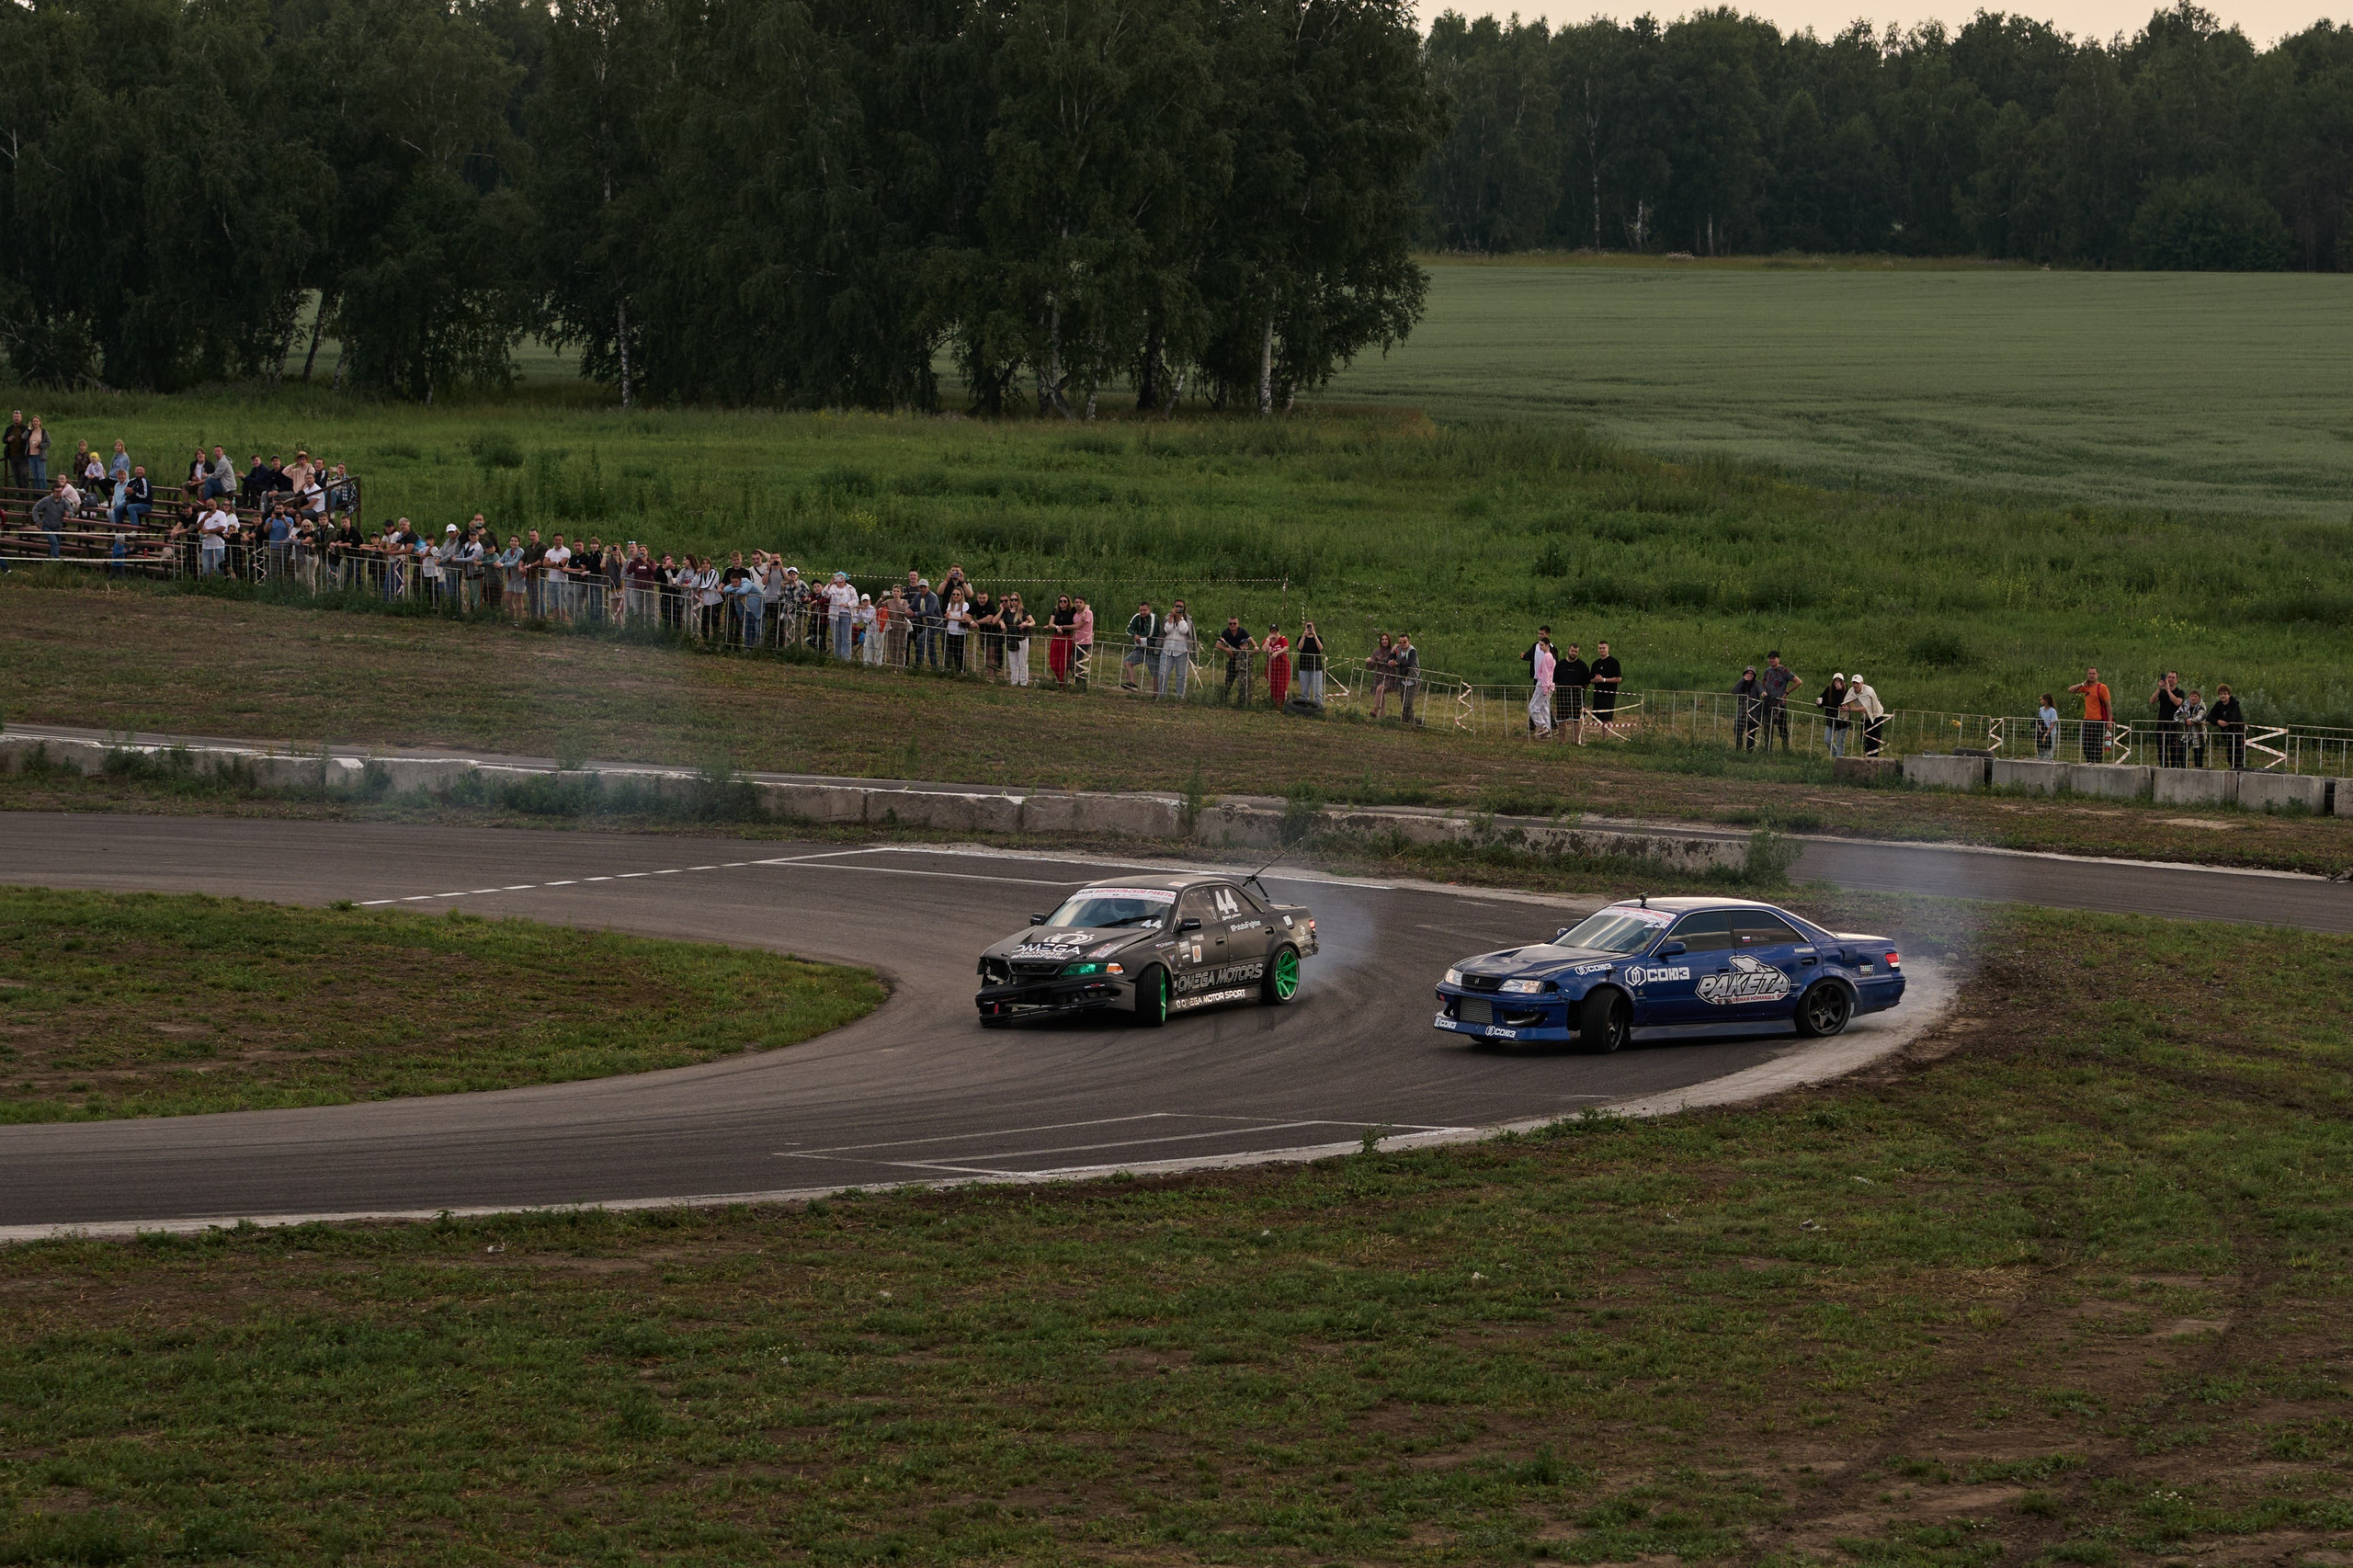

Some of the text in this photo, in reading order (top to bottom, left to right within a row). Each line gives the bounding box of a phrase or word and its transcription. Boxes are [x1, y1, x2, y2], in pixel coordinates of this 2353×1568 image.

[1215, 889, 1239, 913] 44
[1141, 919, 1163, 929] 44
[1011, 943, 1080, 955] OMEGA
[1587, 963, 1612, 972] СОЮЗ
[1647, 967, 1690, 982] СОЮЗ
[1177, 963, 1264, 992] OMEGA MOTORS
[1697, 972, 1789, 999] РАКЕТА
[1181, 989, 1245, 1007] OEGA MOTOR SPORT
[1495, 1028, 1517, 1039] СОЮЗ
